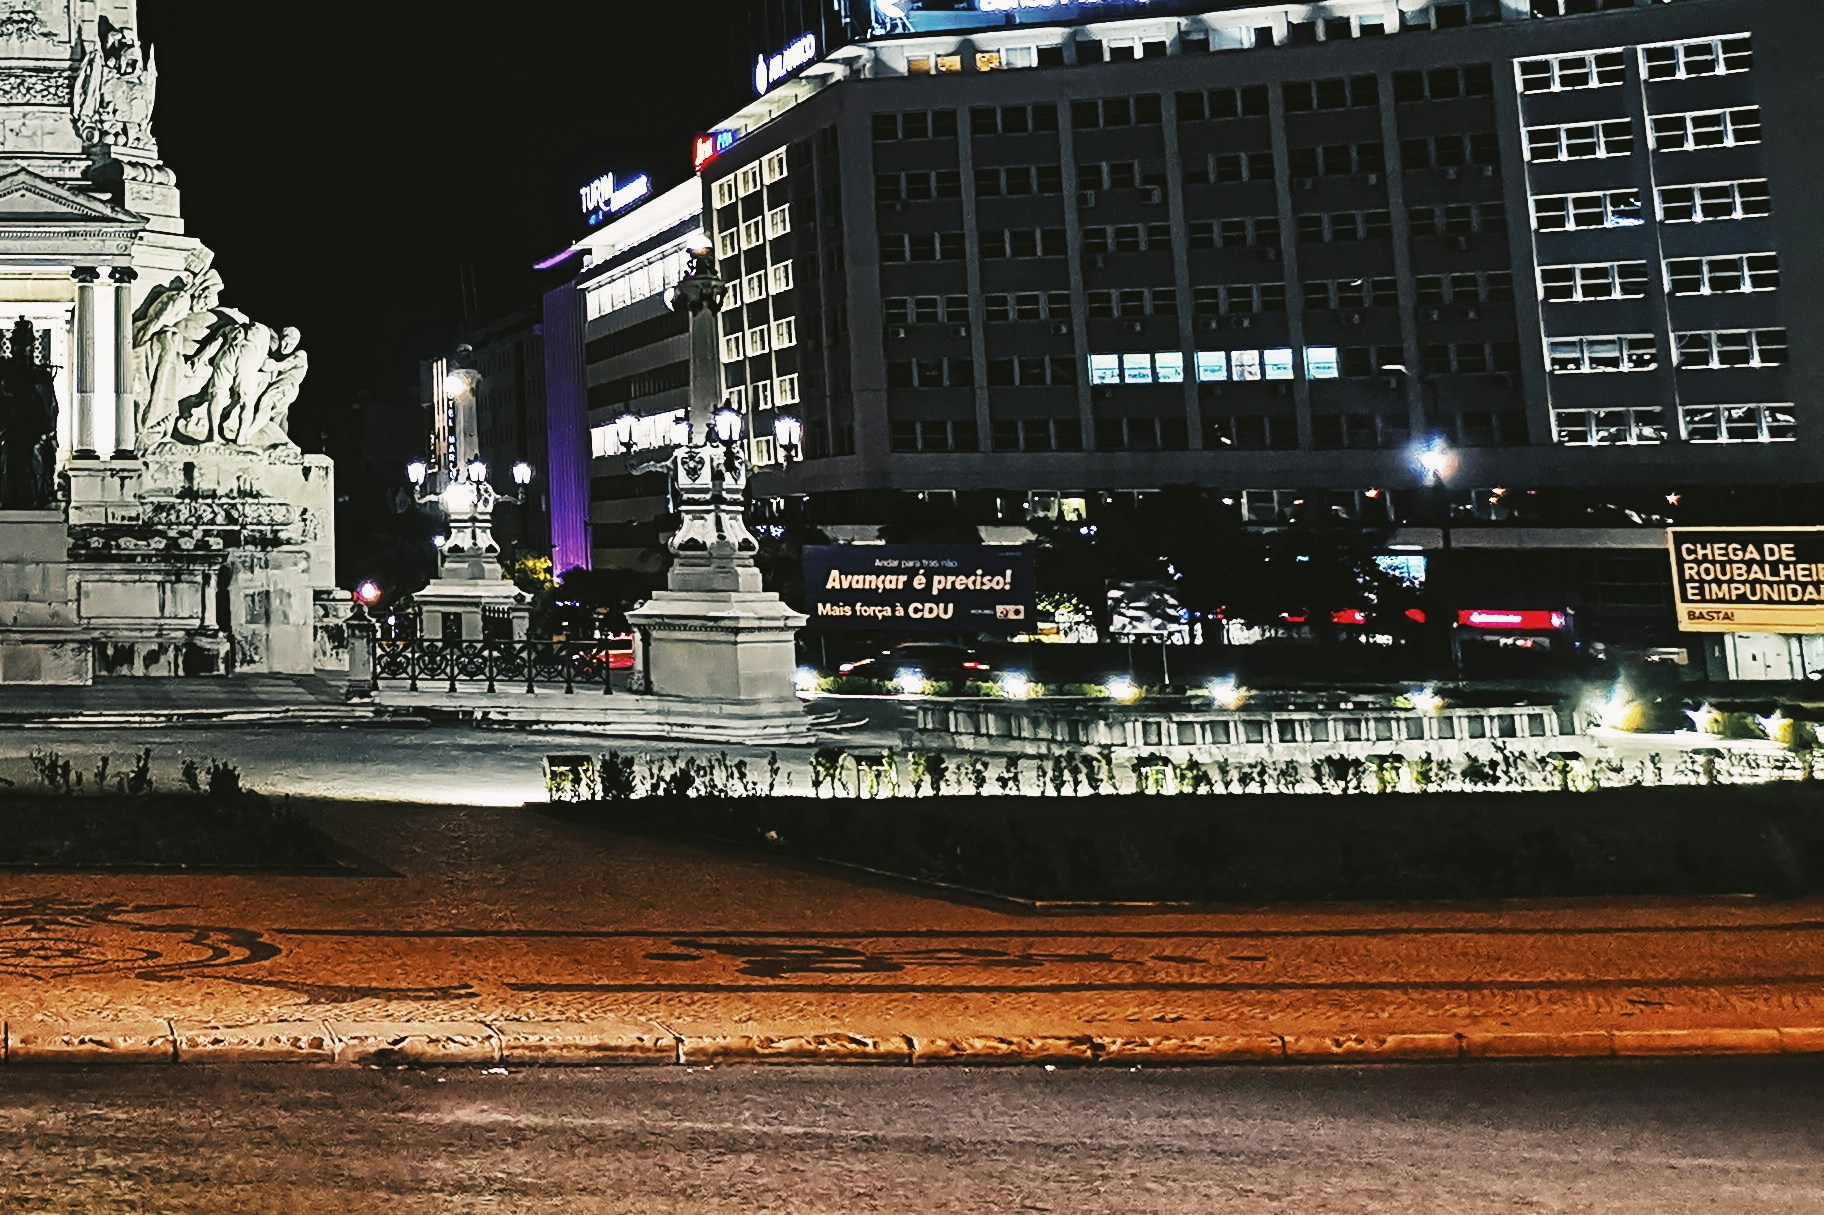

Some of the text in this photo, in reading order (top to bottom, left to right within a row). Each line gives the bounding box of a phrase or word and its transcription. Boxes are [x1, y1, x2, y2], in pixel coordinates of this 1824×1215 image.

[1681, 543, 1797, 561] CHEGA DE
[825, 569, 1013, 596] Avançar é preciso!
[1686, 583, 1702, 600] E
[817, 602, 853, 616] Mais
[855, 602, 891, 620] força
[894, 602, 905, 616] à
[907, 602, 954, 619] CDU
[1687, 610, 1735, 621] BASTA!
